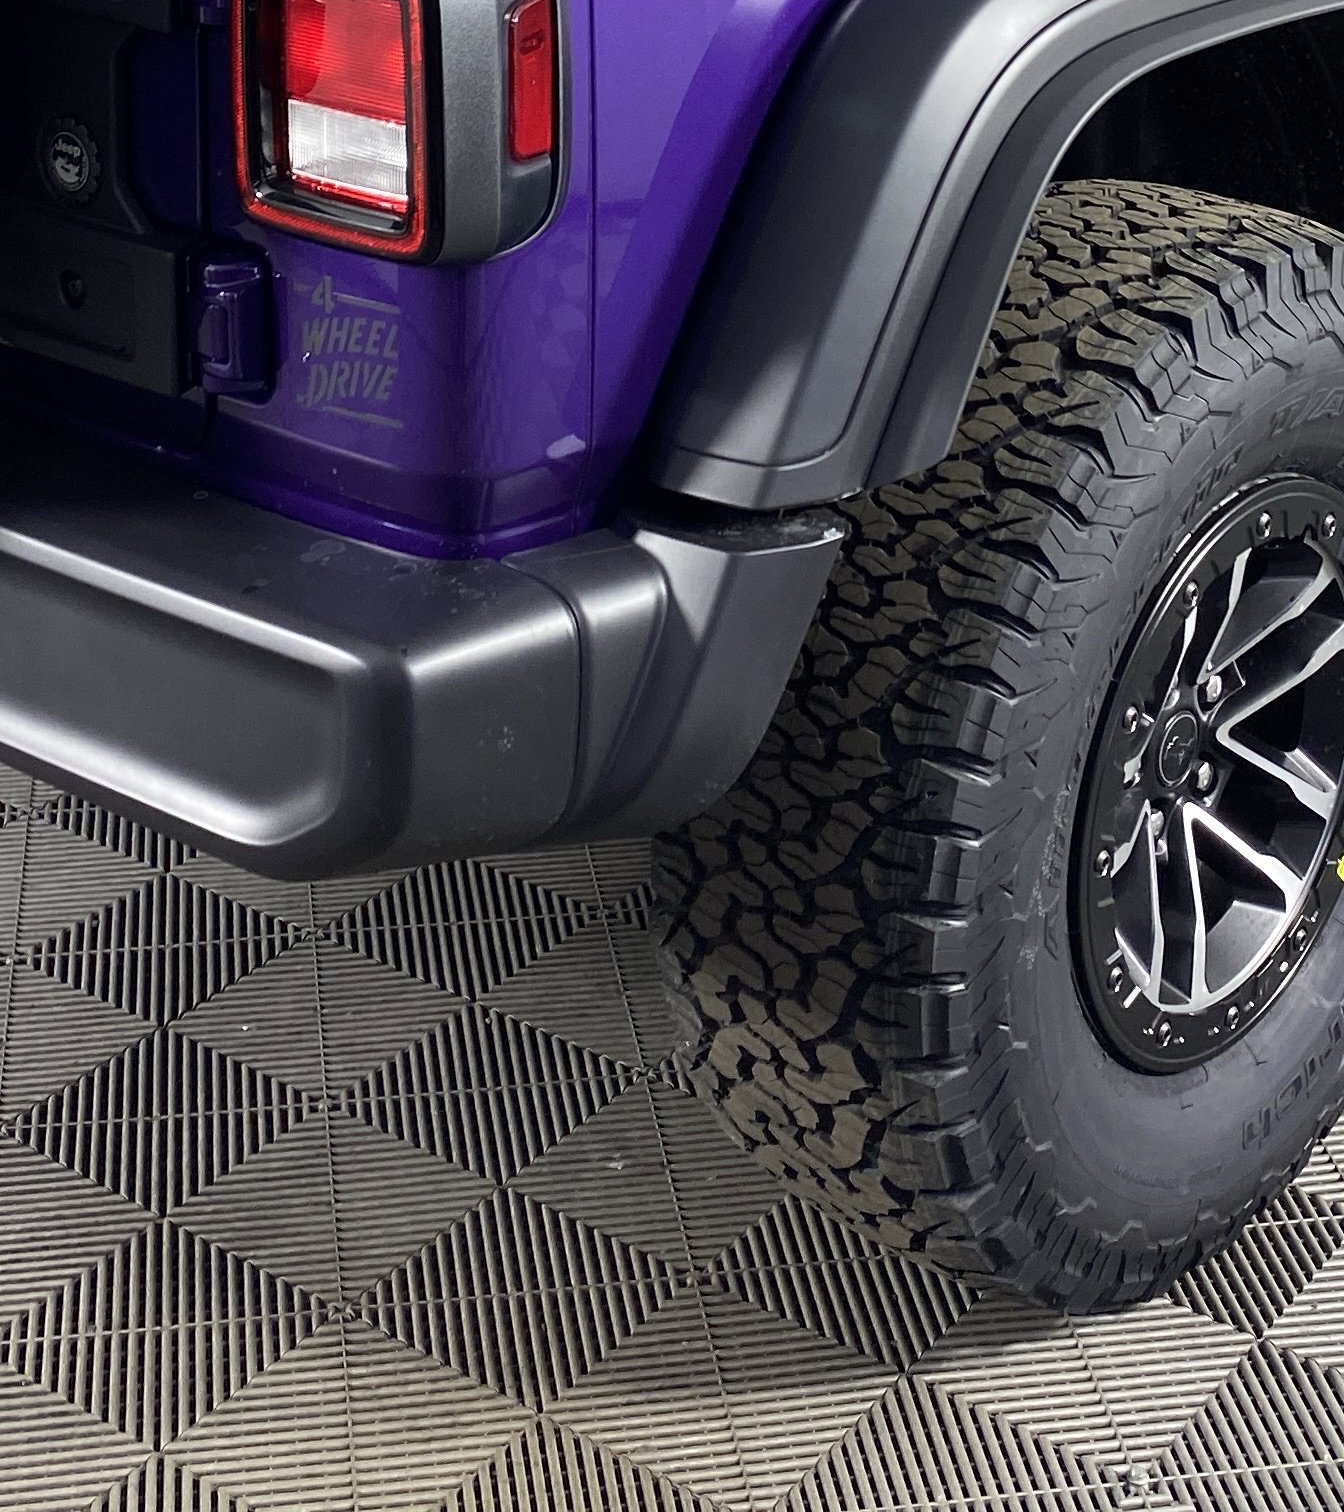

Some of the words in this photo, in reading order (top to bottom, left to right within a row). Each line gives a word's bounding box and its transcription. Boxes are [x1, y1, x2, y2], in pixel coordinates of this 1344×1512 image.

[312, 275, 335, 314] 4
[301, 316, 399, 360] WHEEL
[297, 361, 398, 408] DRIVE
